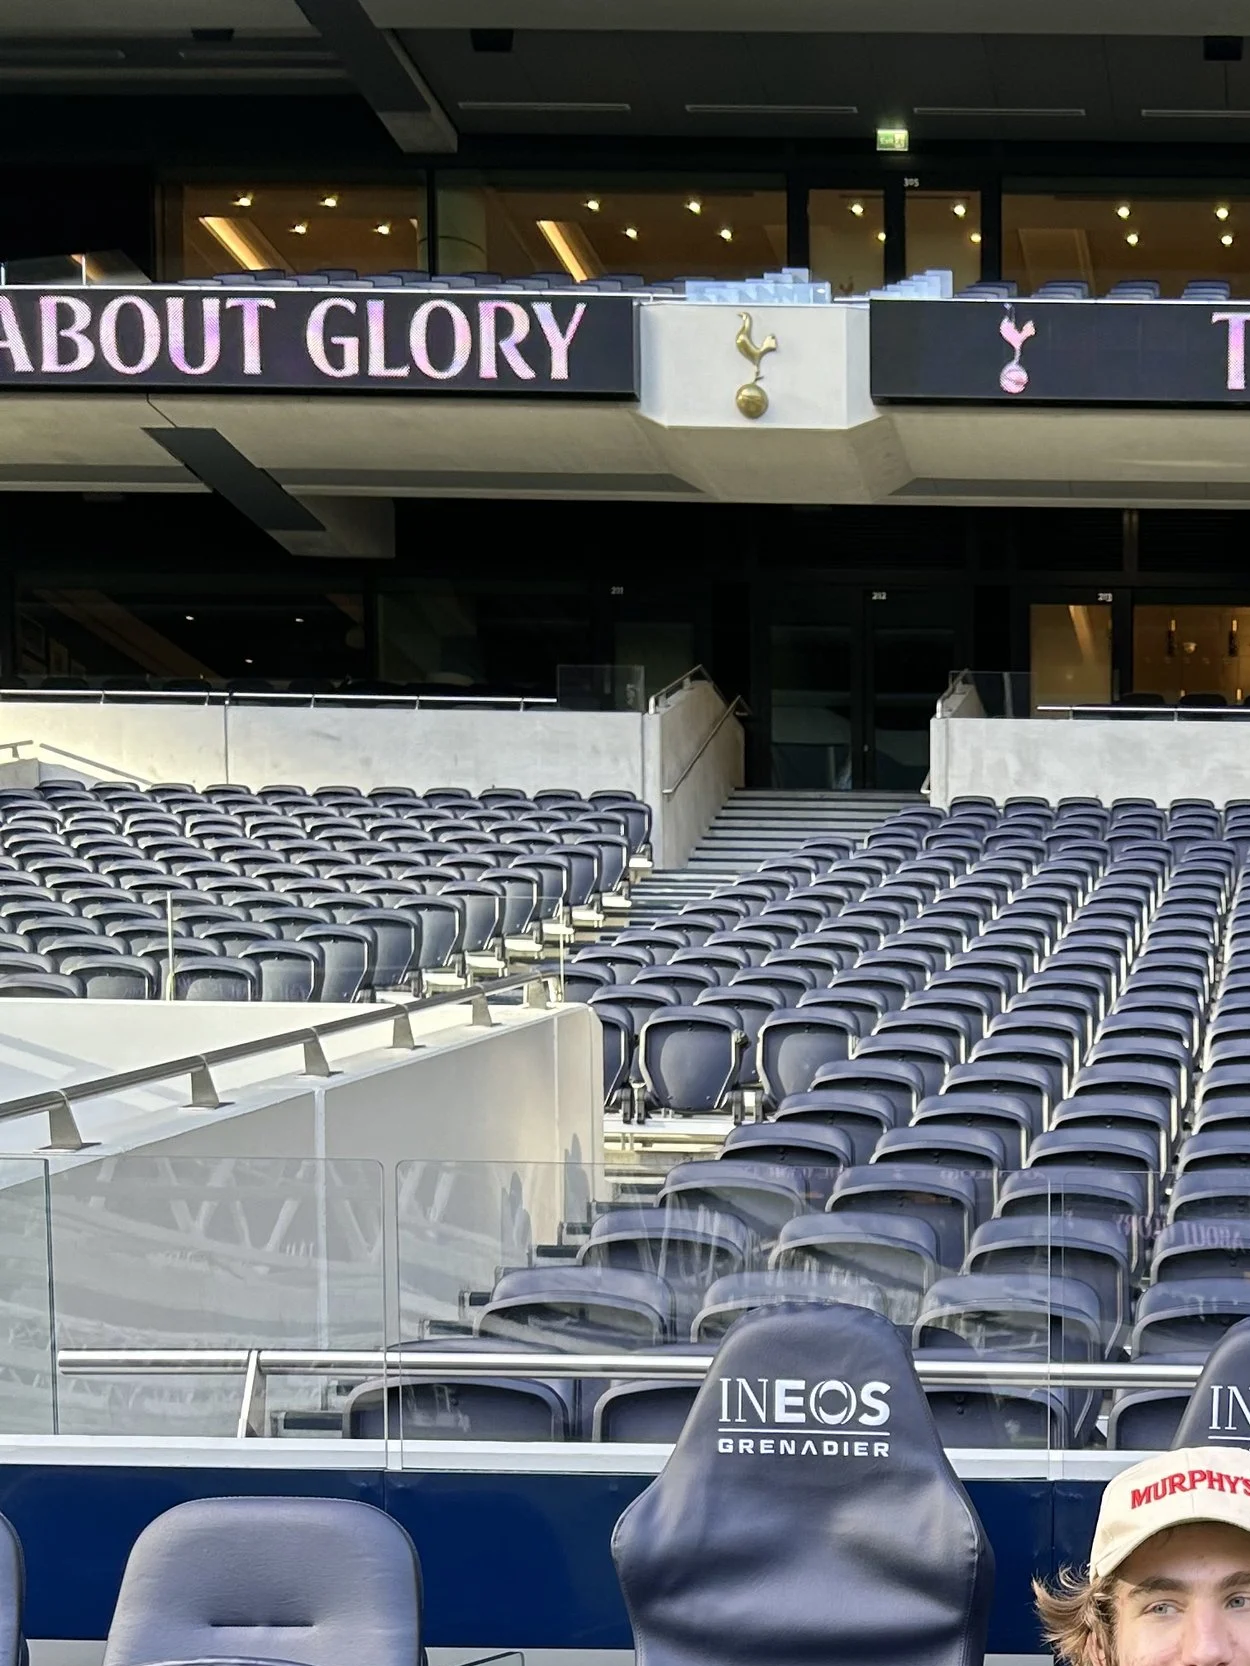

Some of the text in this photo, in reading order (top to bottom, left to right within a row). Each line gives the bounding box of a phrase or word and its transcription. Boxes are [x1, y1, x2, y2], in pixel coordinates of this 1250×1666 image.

[306, 299, 588, 380] GLORY
[718, 1376, 891, 1427] INEOS
[717, 1438, 890, 1458] GRENADIER
